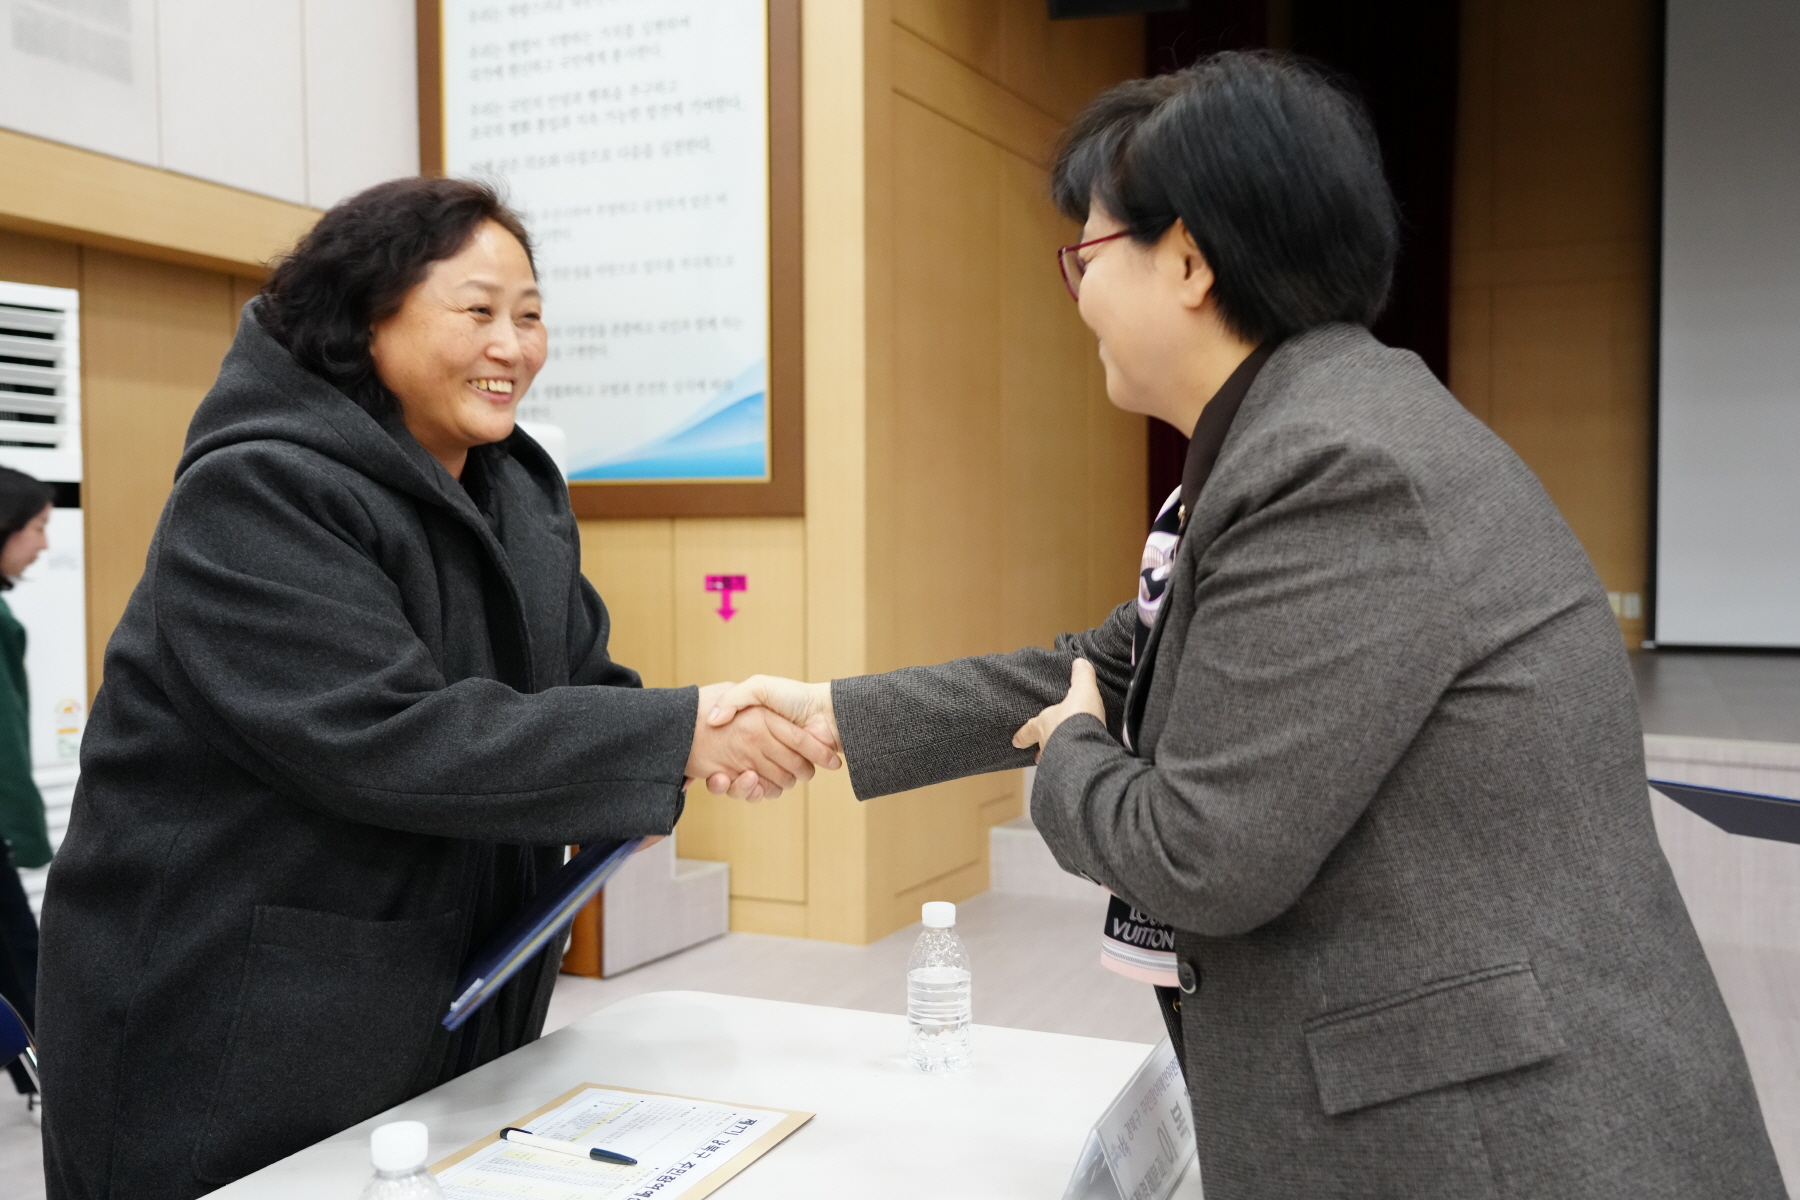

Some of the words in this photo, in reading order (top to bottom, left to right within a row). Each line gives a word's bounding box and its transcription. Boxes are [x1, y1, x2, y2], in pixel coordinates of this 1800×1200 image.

[1113, 917, 1175, 949] VUITTON
[1124, 1108, 1142, 1141] 강북구
[694, 1139, 731, 1159] 강북구
